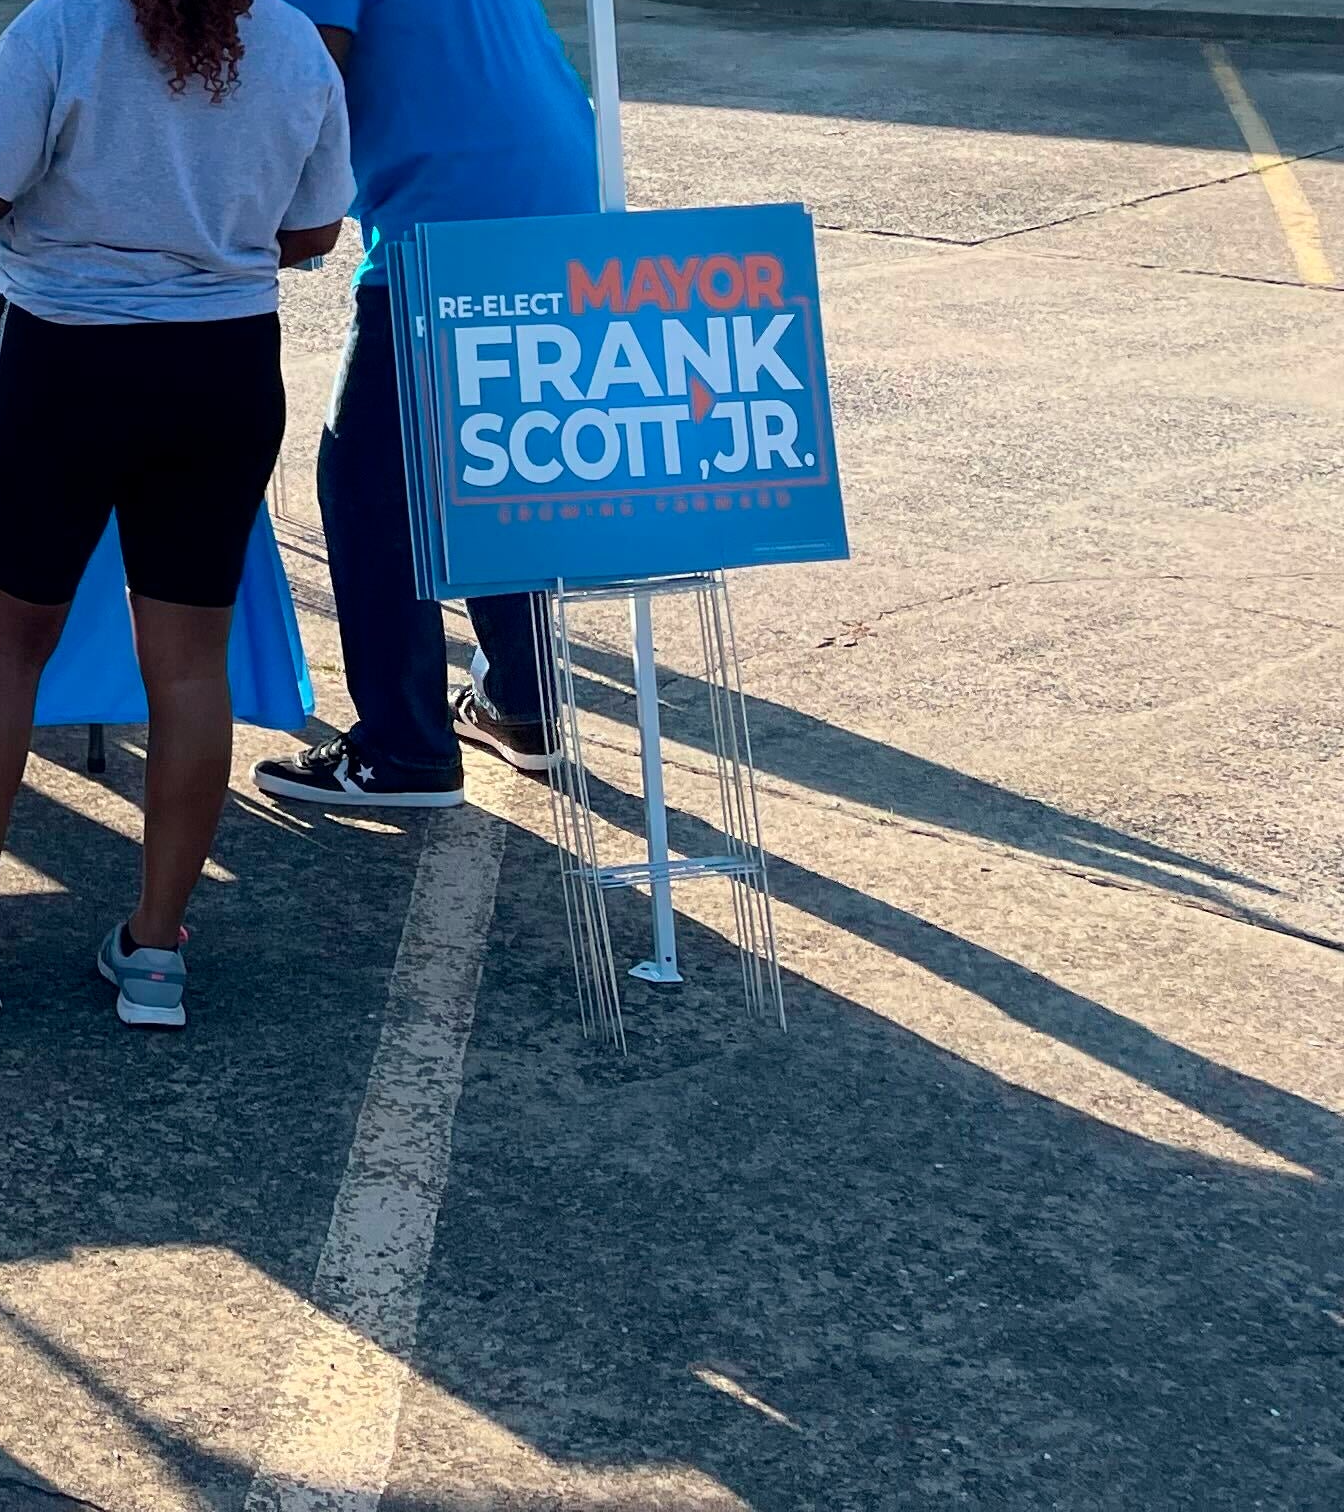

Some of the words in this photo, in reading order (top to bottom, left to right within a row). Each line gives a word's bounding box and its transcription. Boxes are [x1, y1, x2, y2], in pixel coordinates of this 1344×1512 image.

[438, 292, 564, 319] RE-ELECT
[565, 252, 785, 316] MAYOR
[454, 313, 805, 406] FRANK
